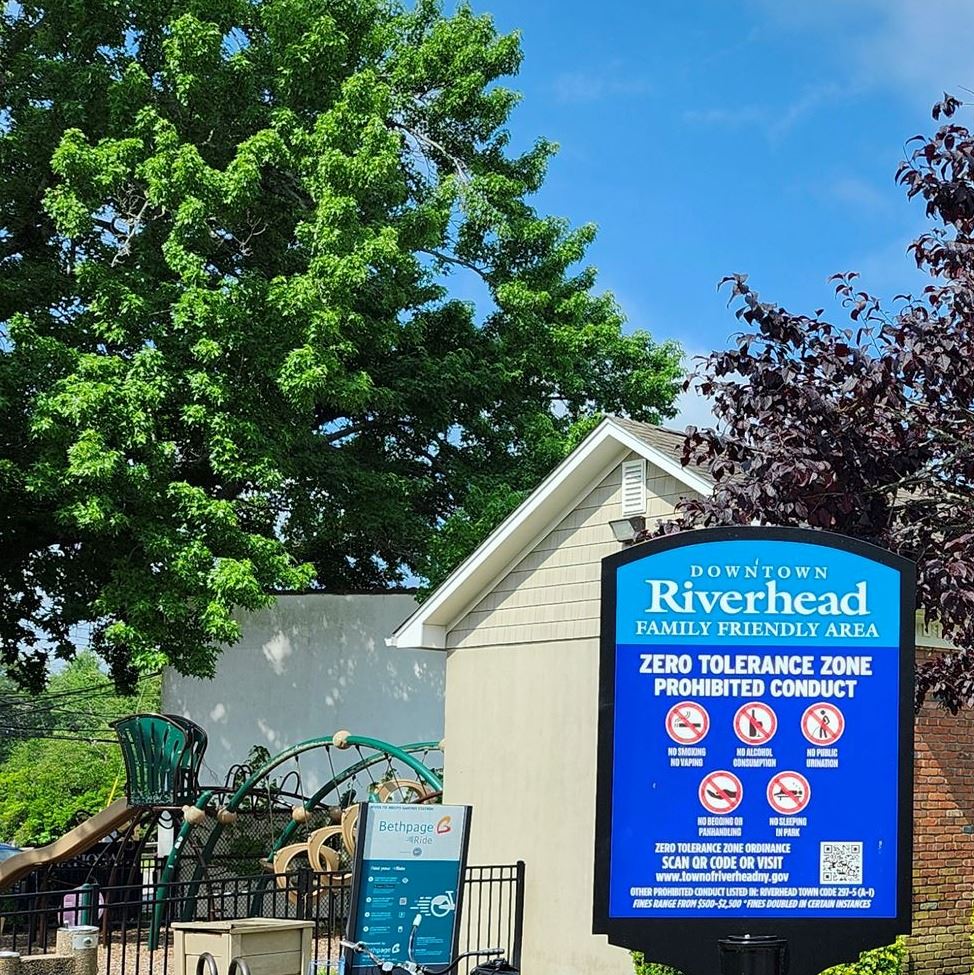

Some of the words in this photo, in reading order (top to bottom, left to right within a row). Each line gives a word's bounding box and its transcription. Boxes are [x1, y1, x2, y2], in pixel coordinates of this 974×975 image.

[691, 566, 828, 579] DOWNTOWN
[645, 580, 870, 615] Riverhead
[637, 621, 711, 635] FAMILY
[718, 622, 819, 636] FRIENDLY
[826, 623, 878, 637] AREA
[640, 654, 692, 674] ZERO
[698, 655, 814, 675] TOLERANCE
[820, 656, 872, 675] ZONE
[655, 678, 765, 696] PROHIBITED
[770, 679, 857, 697] CONDUCT
[668, 747, 677, 756] NO
[678, 747, 706, 756] SMOKING
[737, 748, 745, 756] NO
[746, 748, 773, 757] ALCOHOL
[807, 748, 816, 757] NO
[817, 748, 837, 757] PUBLIC
[671, 758, 680, 766] NO
[680, 758, 703, 766] VAPING
[733, 758, 776, 767] CONSUMPTION
[807, 759, 838, 767] URINATION
[698, 817, 707, 826] NO
[770, 817, 779, 826] NO
[779, 817, 807, 826] SLEEPING
[379, 820, 434, 834] Bethpage
[699, 828, 741, 836] PANHANDLING
[776, 828, 783, 836] IN
[784, 828, 800, 836] PARK
[413, 836, 432, 844] Ride
[655, 843, 676, 853] ZERO
[677, 843, 722, 853] TOLERANCE
[723, 843, 744, 853] ZONE
[745, 843, 790, 853] ORDINANCE
[662, 856, 689, 869] SCAN
[692, 856, 708, 869] QR
[710, 856, 737, 869] CODE
[739, 856, 755, 869] OR
[757, 856, 783, 869] VISIT
[656, 871, 789, 883] www.townofriverheadny.gov
[630, 887, 652, 896] OTHER
[653, 887, 694, 896] PROHIBITED
[694, 887, 725, 896] CONDUCT
[726, 887, 748, 896] LISTED
[749, 888, 759, 896] IN:
[760, 888, 797, 896] RIVERHEAD
[798, 888, 819, 896] TOWN
[819, 888, 837, 896] CODE
[838, 888, 857, 896] 297-5
[633, 899, 653, 908] FINES
[653, 899, 676, 908] RANGE
[677, 899, 697, 908] FROM
[697, 899, 742, 909] $500-$2,500
[766, 899, 797, 908] DOUBLED
[798, 899, 807, 908] IN
[807, 900, 835, 908] CERTAIN
[835, 900, 871, 908] INSTANCES
